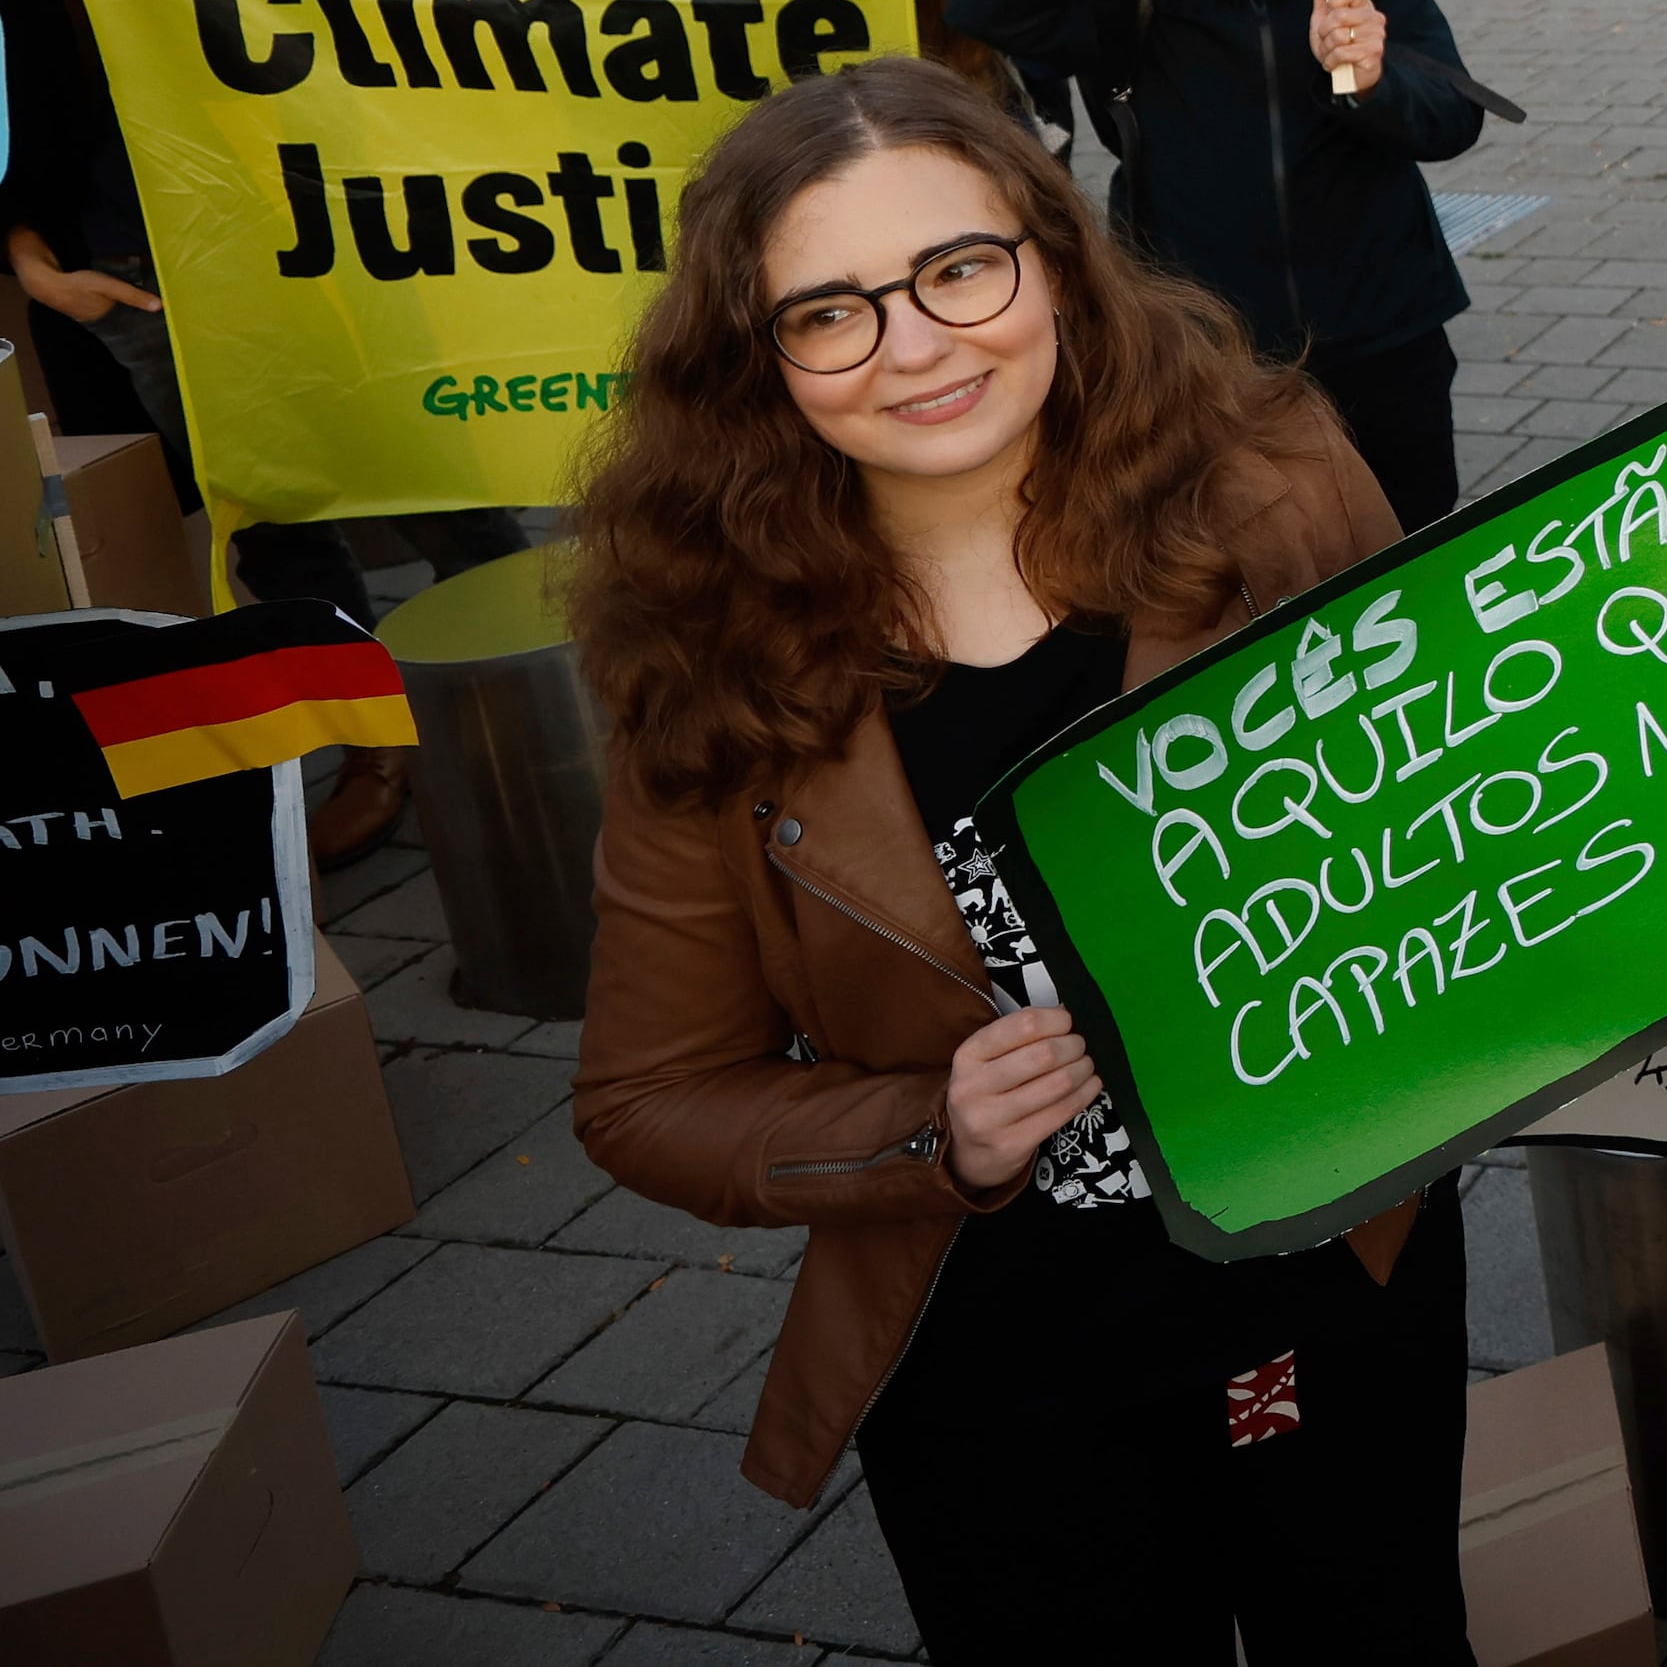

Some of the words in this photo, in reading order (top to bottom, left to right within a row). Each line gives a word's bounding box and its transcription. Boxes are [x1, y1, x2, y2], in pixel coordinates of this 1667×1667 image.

[1096, 589, 1418, 817] VOCÊS
[1151, 638, 1563, 908] AQUILO
[1193, 726, 1609, 1009] ADULTOS
